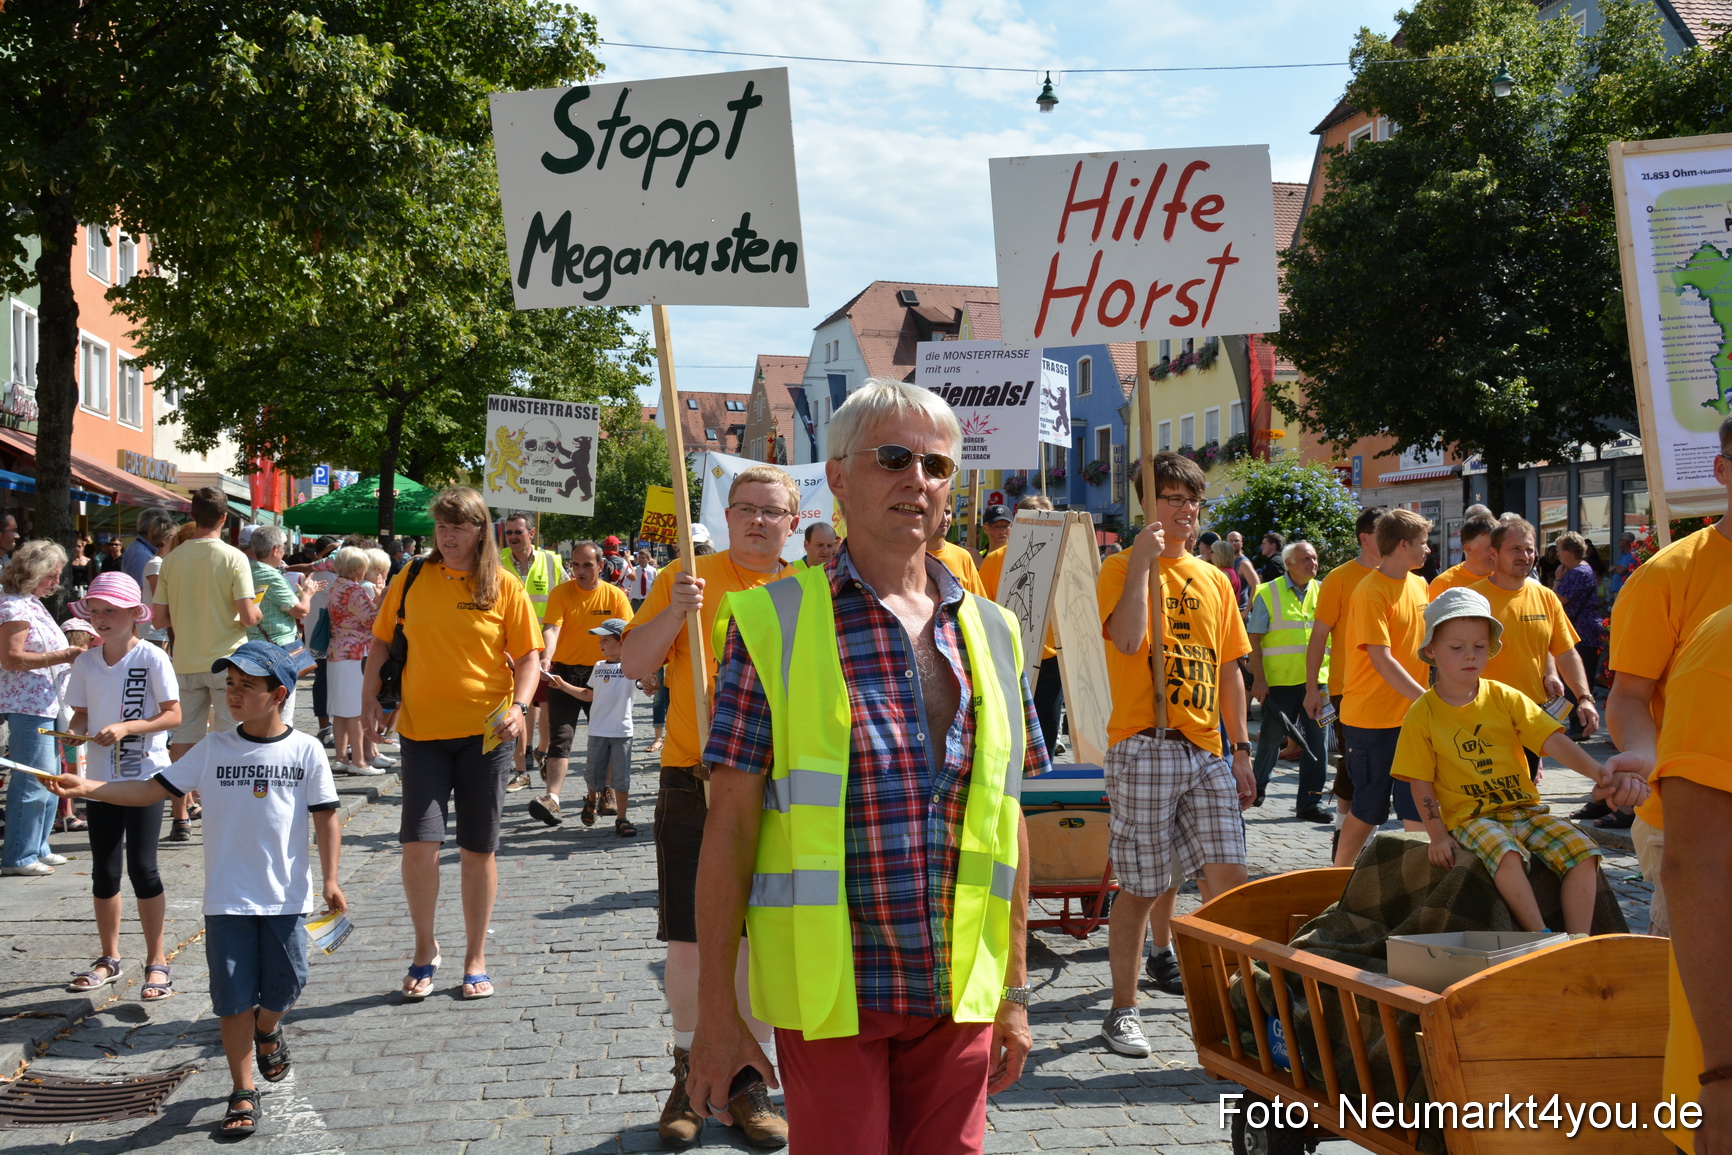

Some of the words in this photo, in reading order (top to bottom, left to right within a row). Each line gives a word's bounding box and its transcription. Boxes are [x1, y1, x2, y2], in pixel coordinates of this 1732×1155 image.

[541, 80, 763, 190] Stoppt
[1641, 170, 1670, 181] 21.853
[1056, 160, 1225, 243] Hilfe
[517, 210, 798, 301] Megamasten
[1033, 241, 1240, 338] Horst
[925, 350, 941, 361] die
[942, 349, 1031, 361] MONSTERTRASSE
[925, 365, 942, 374] mit
[943, 365, 961, 374] uns
[1042, 360, 1068, 376] TRASSE
[488, 397, 599, 421] MONSTERTRASSE
[963, 436, 986, 444] BÜRGER-
[316, 467, 325, 483] P
[519, 477, 530, 485] Ein
[530, 478, 563, 488] Geschenk
[535, 486, 547, 495] Für
[528, 494, 552, 504] Bayern
[799, 509, 821, 519] sse
[1149, 643, 1218, 663] RASSEN
[1166, 678, 1215, 712] 7.01
[216, 765, 304, 781] DEUTSCHLAND
[1461, 774, 1520, 796] TRASSEN
